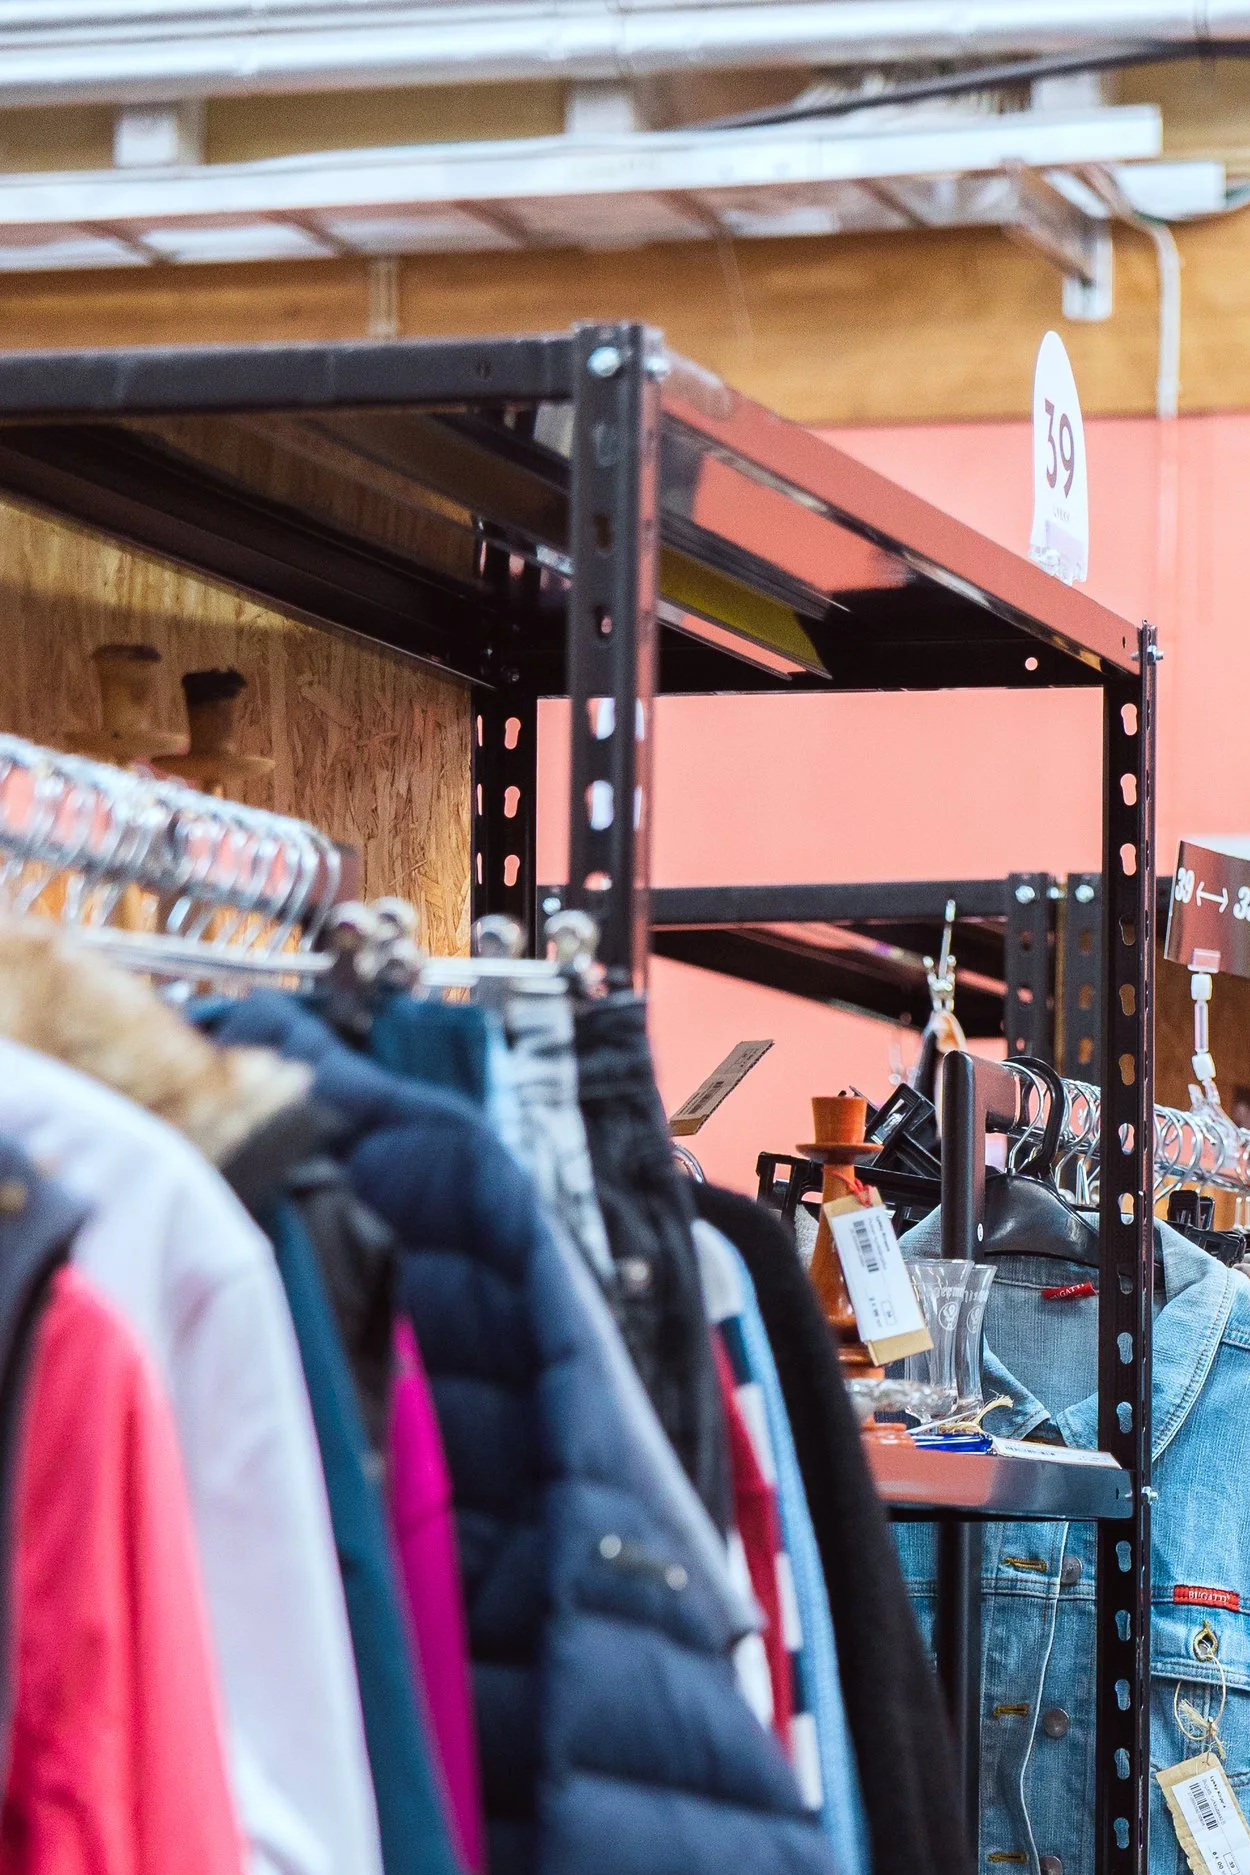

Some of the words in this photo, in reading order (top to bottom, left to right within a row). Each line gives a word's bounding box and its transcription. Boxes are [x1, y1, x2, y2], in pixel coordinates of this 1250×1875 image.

[1044, 398, 1075, 499] 39
[1174, 867, 1195, 904] 39
[1188, 1591, 1230, 1604] BUGATTI
